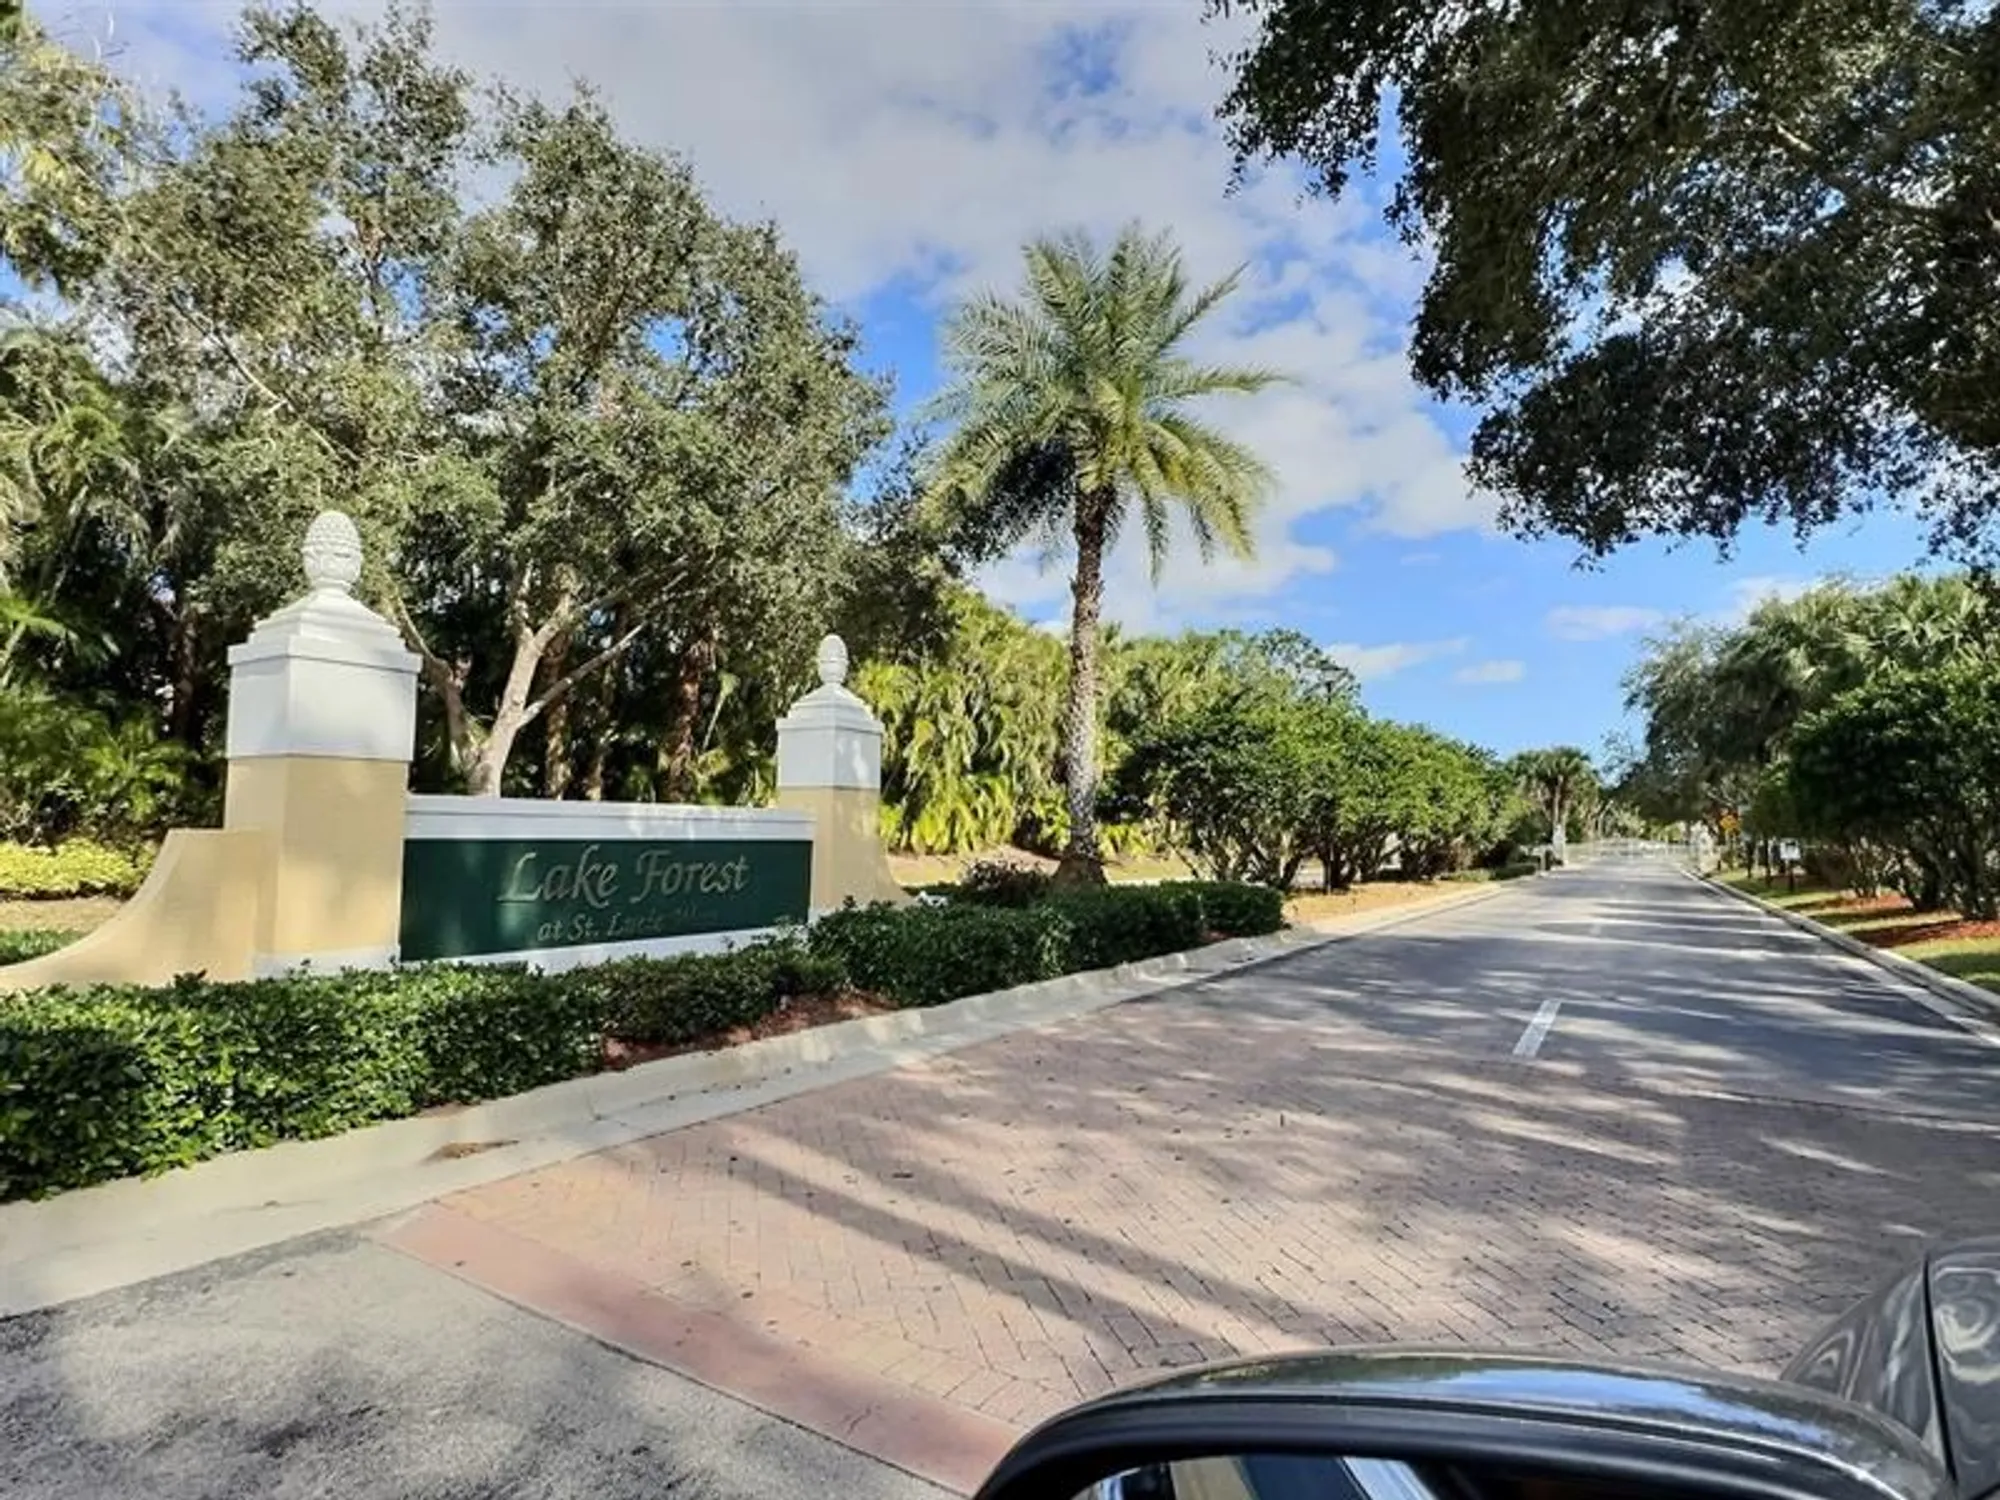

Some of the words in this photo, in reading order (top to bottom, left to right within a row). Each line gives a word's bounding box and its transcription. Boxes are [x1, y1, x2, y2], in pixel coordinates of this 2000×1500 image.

[498, 844, 619, 909] Lake
[629, 849, 749, 904] Forest
[537, 920, 564, 942] at
[567, 913, 599, 941] St.
